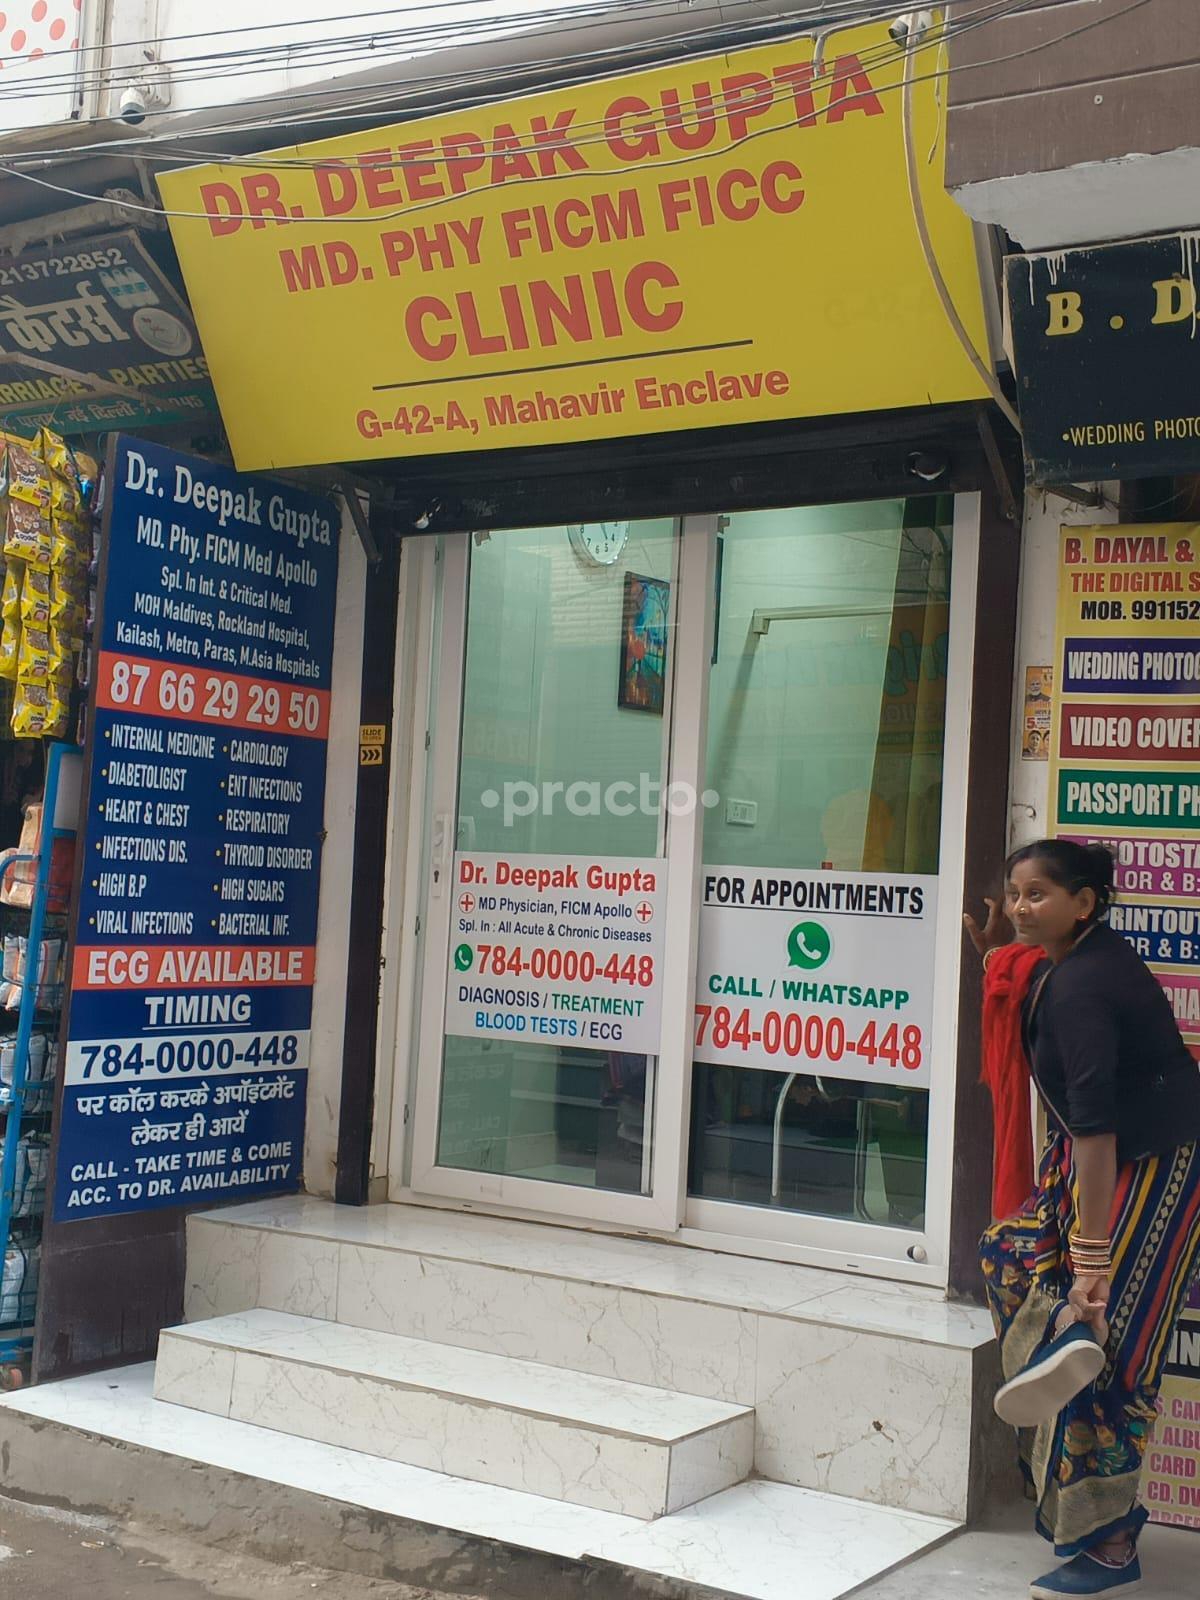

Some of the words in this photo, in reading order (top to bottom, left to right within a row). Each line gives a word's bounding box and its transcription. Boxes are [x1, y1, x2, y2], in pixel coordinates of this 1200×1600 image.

[200, 172, 303, 236] DR.
[316, 109, 591, 200] DEEPAK
[603, 56, 884, 161] GUPTA
[279, 243, 373, 293] MD.
[382, 218, 486, 276] PHY
[501, 190, 644, 259] FICM
[664, 161, 805, 232] FICC
[404, 261, 684, 362] CLINIC
[356, 396, 479, 439] G-42-A,
[487, 380, 625, 428] Mahavir
[637, 370, 790, 410] Enclave
[1070, 422, 1145, 446] WEDDING
[125, 451, 164, 498] Dr.
[174, 465, 262, 527] Deepak
[268, 495, 331, 548] Gupta
[137, 515, 165, 549] MD.
[170, 524, 200, 563] Phy.
[205, 533, 239, 568] FICM
[243, 547, 272, 576] Med
[276, 553, 317, 588] Apollo
[1065, 537, 1087, 564] B.
[1094, 537, 1168, 564] DAYAL
[1175, 539, 1193, 562] &
[161, 566, 182, 591] Spl.
[185, 572, 197, 592] In
[199, 575, 216, 598] Int.
[219, 581, 227, 599] &
[230, 583, 267, 609] Critical
[271, 593, 293, 615] Med.
[1071, 572, 1105, 593] THE
[1110, 571, 1183, 593] DIGITAL
[135, 592, 160, 616] MOH
[163, 598, 215, 632] Maldives,
[218, 611, 265, 640] Rockland
[268, 620, 310, 651] Hospital,
[1081, 601, 1127, 620] MOB.
[1131, 600, 1200, 620] 991152
[117, 621, 162, 653] Kailash,
[166, 631, 201, 660] Metro,
[204, 641, 237, 667] Paras,
[240, 647, 272, 670] M.Asia
[276, 651, 320, 679] Hospitals
[1068, 651, 1139, 680] WEDDING
[110, 661, 150, 705] 87
[159, 669, 195, 713] 66
[203, 677, 239, 719] 29
[247, 684, 280, 726] 29
[288, 692, 320, 731] 50
[112, 724, 164, 753] INTERNAL
[167, 731, 215, 759] MEDICINE
[1070, 716, 1132, 747] VIDEO
[230, 739, 288, 768] CARDIOLOGY
[108, 761, 187, 792] DIABETOLIGIST
[228, 774, 246, 797] ENT
[249, 777, 302, 803] INFECTIONS
[105, 798, 142, 825] HEART
[144, 801, 153, 826] &
[156, 802, 190, 828] CHEST
[1067, 781, 1173, 816] PASSPORT
[226, 809, 290, 835] RESPIRATORY
[102, 836, 166, 863] INFECTIONS
[168, 839, 188, 863] DIS.
[224, 843, 264, 868] THYROID
[266, 847, 312, 871] DISORDER
[99, 873, 125, 898] HIGH
[128, 874, 147, 898] B.P
[221, 878, 245, 901] HIGH
[247, 879, 285, 902] SUGARS
[460, 860, 488, 885] Dr.
[495, 861, 579, 892] Deepak
[586, 865, 656, 897] Gupta
[1160, 872, 1174, 891] &
[478, 896, 497, 911] MD
[500, 898, 558, 916] Physician,
[560, 900, 591, 915] FICM
[593, 903, 632, 920] Apollo
[704, 876, 745, 904] FOR
[751, 878, 924, 915] APPOINTMENTS
[96, 910, 128, 934] VIRAL
[131, 911, 194, 935] INFECTIONS
[219, 914, 270, 936] BACTERIAL
[272, 914, 290, 936] INF.
[458, 918, 478, 936] Spl.
[480, 920, 490, 932] In
[498, 921, 512, 933] All
[514, 921, 544, 936] Acute
[547, 923, 555, 937] &
[558, 925, 600, 940] Chronic
[602, 926, 652, 943] Diseases
[1158, 938, 1172, 958] &
[87, 951, 150, 985] ECG
[156, 951, 303, 983] AVAILABLE
[477, 944, 654, 987] 784-0000-448
[459, 986, 540, 1009] DIAGNOSIS
[552, 993, 644, 1017] TREATMENT
[709, 974, 763, 998] CALL
[782, 980, 910, 1010] WHATSAPP
[144, 994, 251, 1025] TIMING
[475, 1011, 526, 1032] BLOOD
[530, 1015, 577, 1037] TESTS
[589, 1022, 623, 1041] ECG
[695, 1004, 922, 1070] 784-0000-448
[80, 1035, 298, 1079] 784-0000-448
[77, 1094, 104, 1116] पर
[109, 1087, 157, 1113] कॉल
[160, 1081, 210, 1109] करके
[130, 1119, 182, 1146] लेकर
[185, 1112, 207, 1141] ही
[208, 1109, 249, 1137] आयें
[71, 1160, 119, 1182] CALL
[135, 1154, 181, 1175] TAKE
[185, 1148, 226, 1168] TIME
[231, 1147, 242, 1162] &
[248, 1141, 292, 1161] COME
[67, 1185, 111, 1208] ACC.
[117, 1182, 143, 1201] TO
[147, 1178, 176, 1198] DR.
[180, 1163, 291, 1193] AVAILABILITY
[1150, 1452, 1196, 1478] CARD
[1147, 1480, 1174, 1504] CD,
